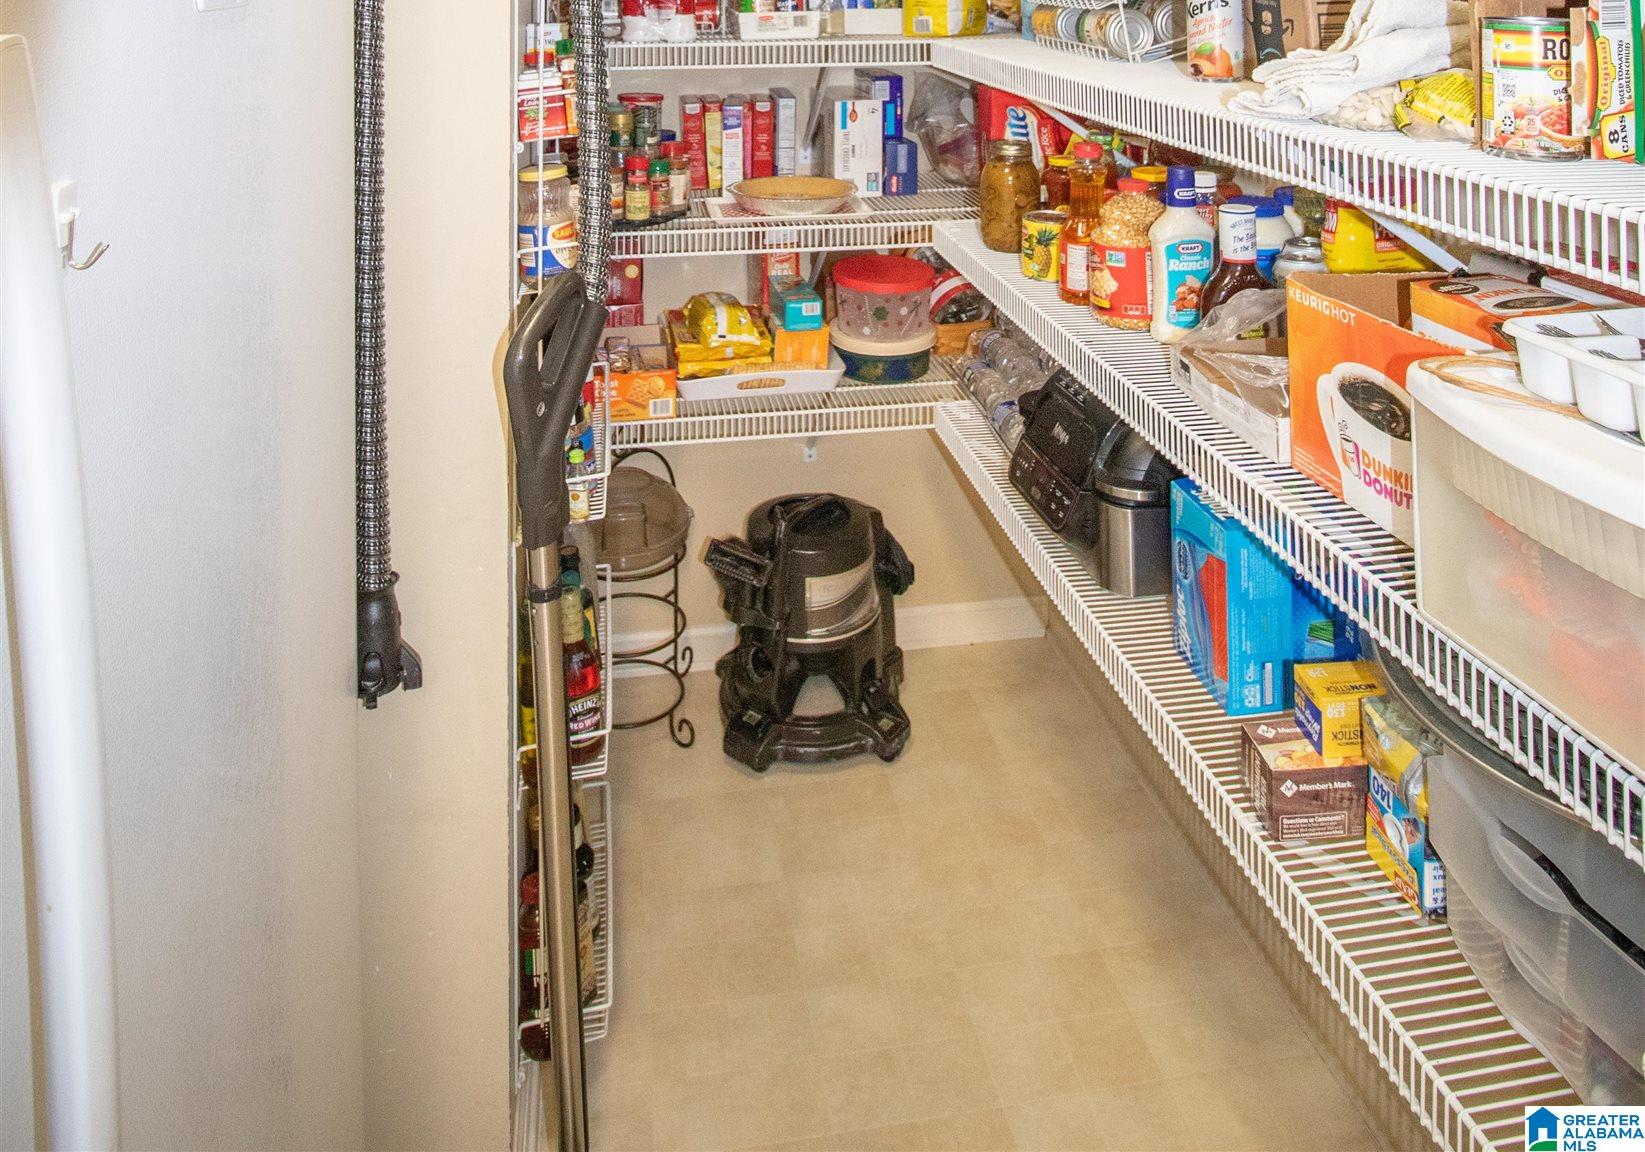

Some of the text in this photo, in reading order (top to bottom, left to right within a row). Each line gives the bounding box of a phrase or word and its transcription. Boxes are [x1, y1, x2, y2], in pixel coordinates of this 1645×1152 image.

[1600, 41, 1609, 106] Original
[1608, 129, 1620, 144] 8
[1619, 114, 1630, 154] CANS
[1168, 258, 1211, 272] Ranch
[1288, 286, 1356, 326] KEURIG HOT
[1362, 468, 1413, 510] DONUT
[1323, 683, 1376, 694] NONSTICK
[571, 698, 598, 716] HEINZ
[570, 713, 601, 731] RED WINE
[1331, 729, 1363, 741] STICK
[1299, 780, 1352, 792] Member's Mark
[1371, 776, 1392, 813] 140
[1395, 876, 1418, 903] GLAD
